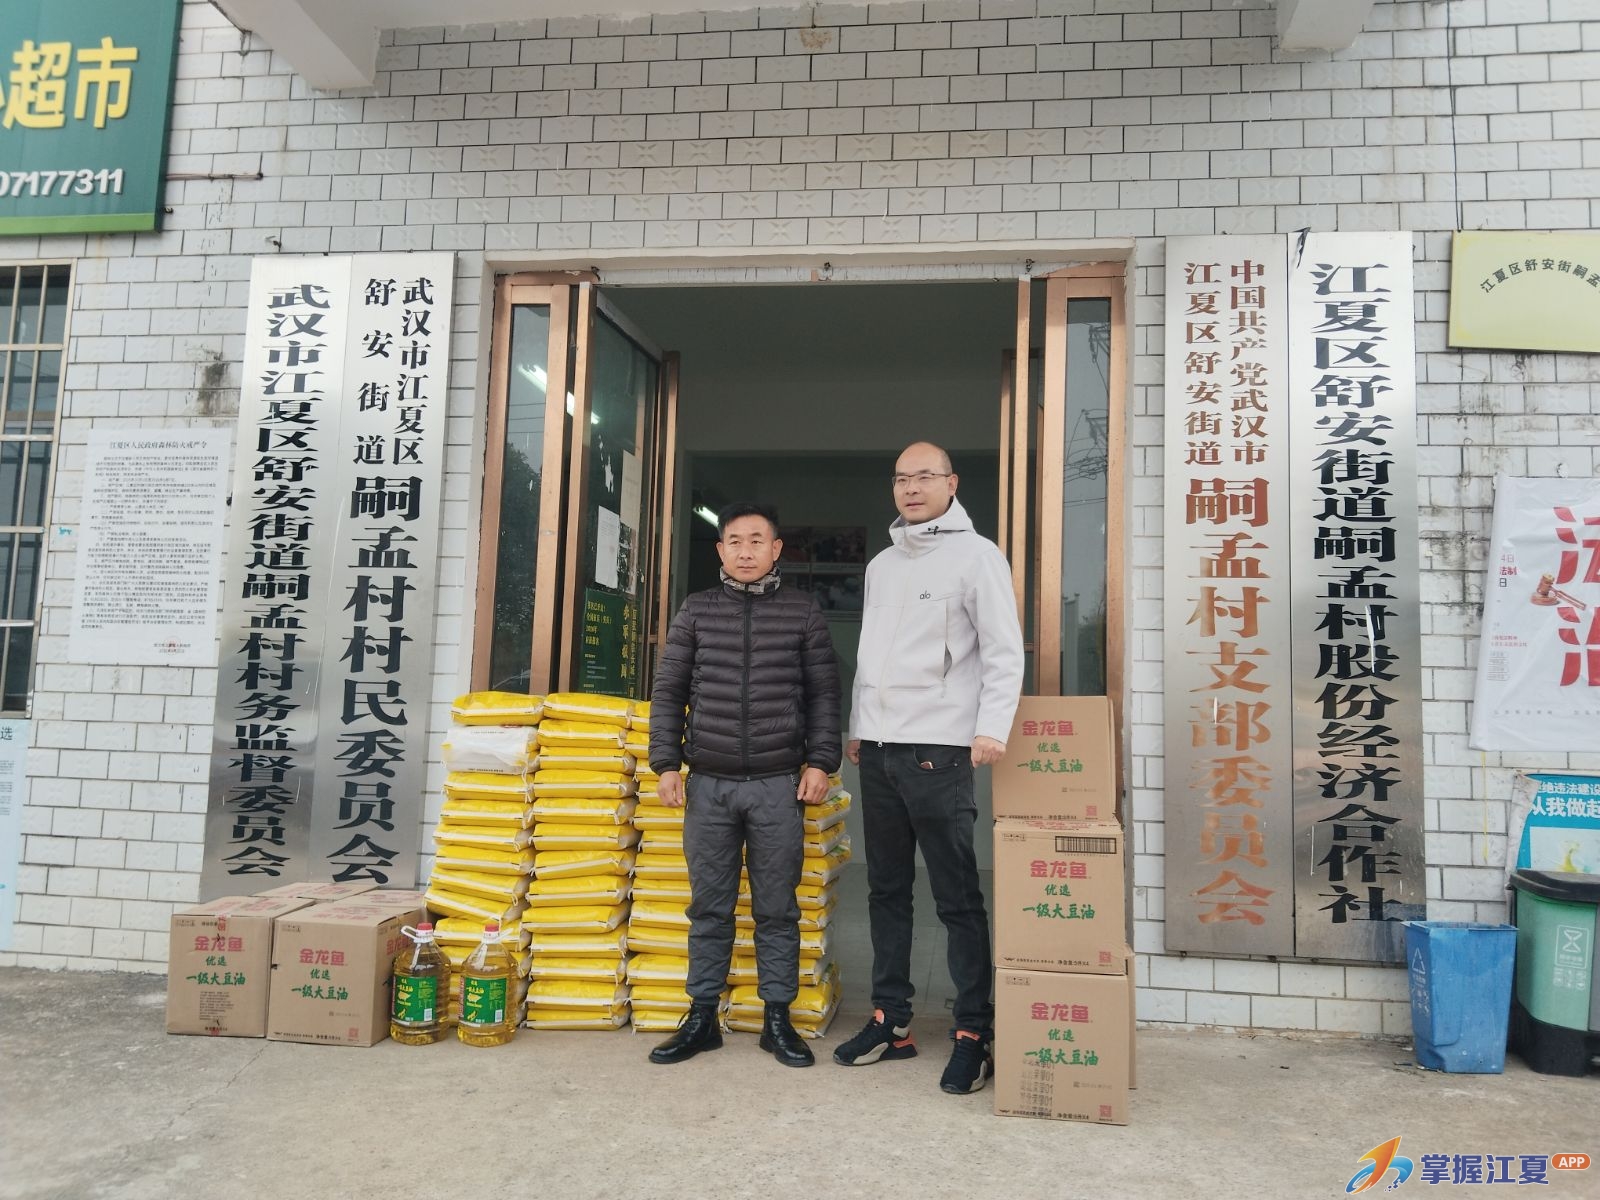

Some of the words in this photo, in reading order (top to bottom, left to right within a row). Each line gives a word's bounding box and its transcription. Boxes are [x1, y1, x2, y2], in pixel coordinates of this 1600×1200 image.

[0, 37, 138, 129] 超市
[353, 278, 397, 465] 舒安街道
[392, 277, 434, 465] 武汉市江夏区
[1184, 262, 1223, 466] 江夏区舒安街道
[1229, 260, 1269, 465] 中国共产党武汉市
[222, 284, 331, 876] 武汉市江夏区舒安街道嗣孟村村务监督委员会
[1309, 263, 1403, 924] 江夏区舒安街道嗣孟村股份经济合作社
[326, 476, 423, 884] 嗣孟村村民委员会
[1185, 478, 1275, 926] 嗣孟村支部委员会
[1022, 720, 1074, 736] 金龙鱼
[1037, 742, 1062, 753] 优选
[1017, 759, 1083, 773] 一级大豆油
[1538, 781, 1600, 795] 绝违法建设
[1030, 860, 1087, 879] 金龙鱼
[1045, 884, 1071, 896] 优选
[1022, 903, 1095, 920] 一级大豆油
[194, 935, 244, 953] 金龙鱼
[205, 955, 228, 967] 优选
[299, 948, 345, 966] 金龙鱼
[186, 972, 246, 986] 一级大豆油
[310, 968, 331, 981] 优选
[291, 984, 349, 1001] 一级大豆油
[1031, 1002, 1089, 1024] 金龙鱼
[1048, 1028, 1075, 1042] 优选
[1024, 1048, 1099, 1067] 一级大豆油
